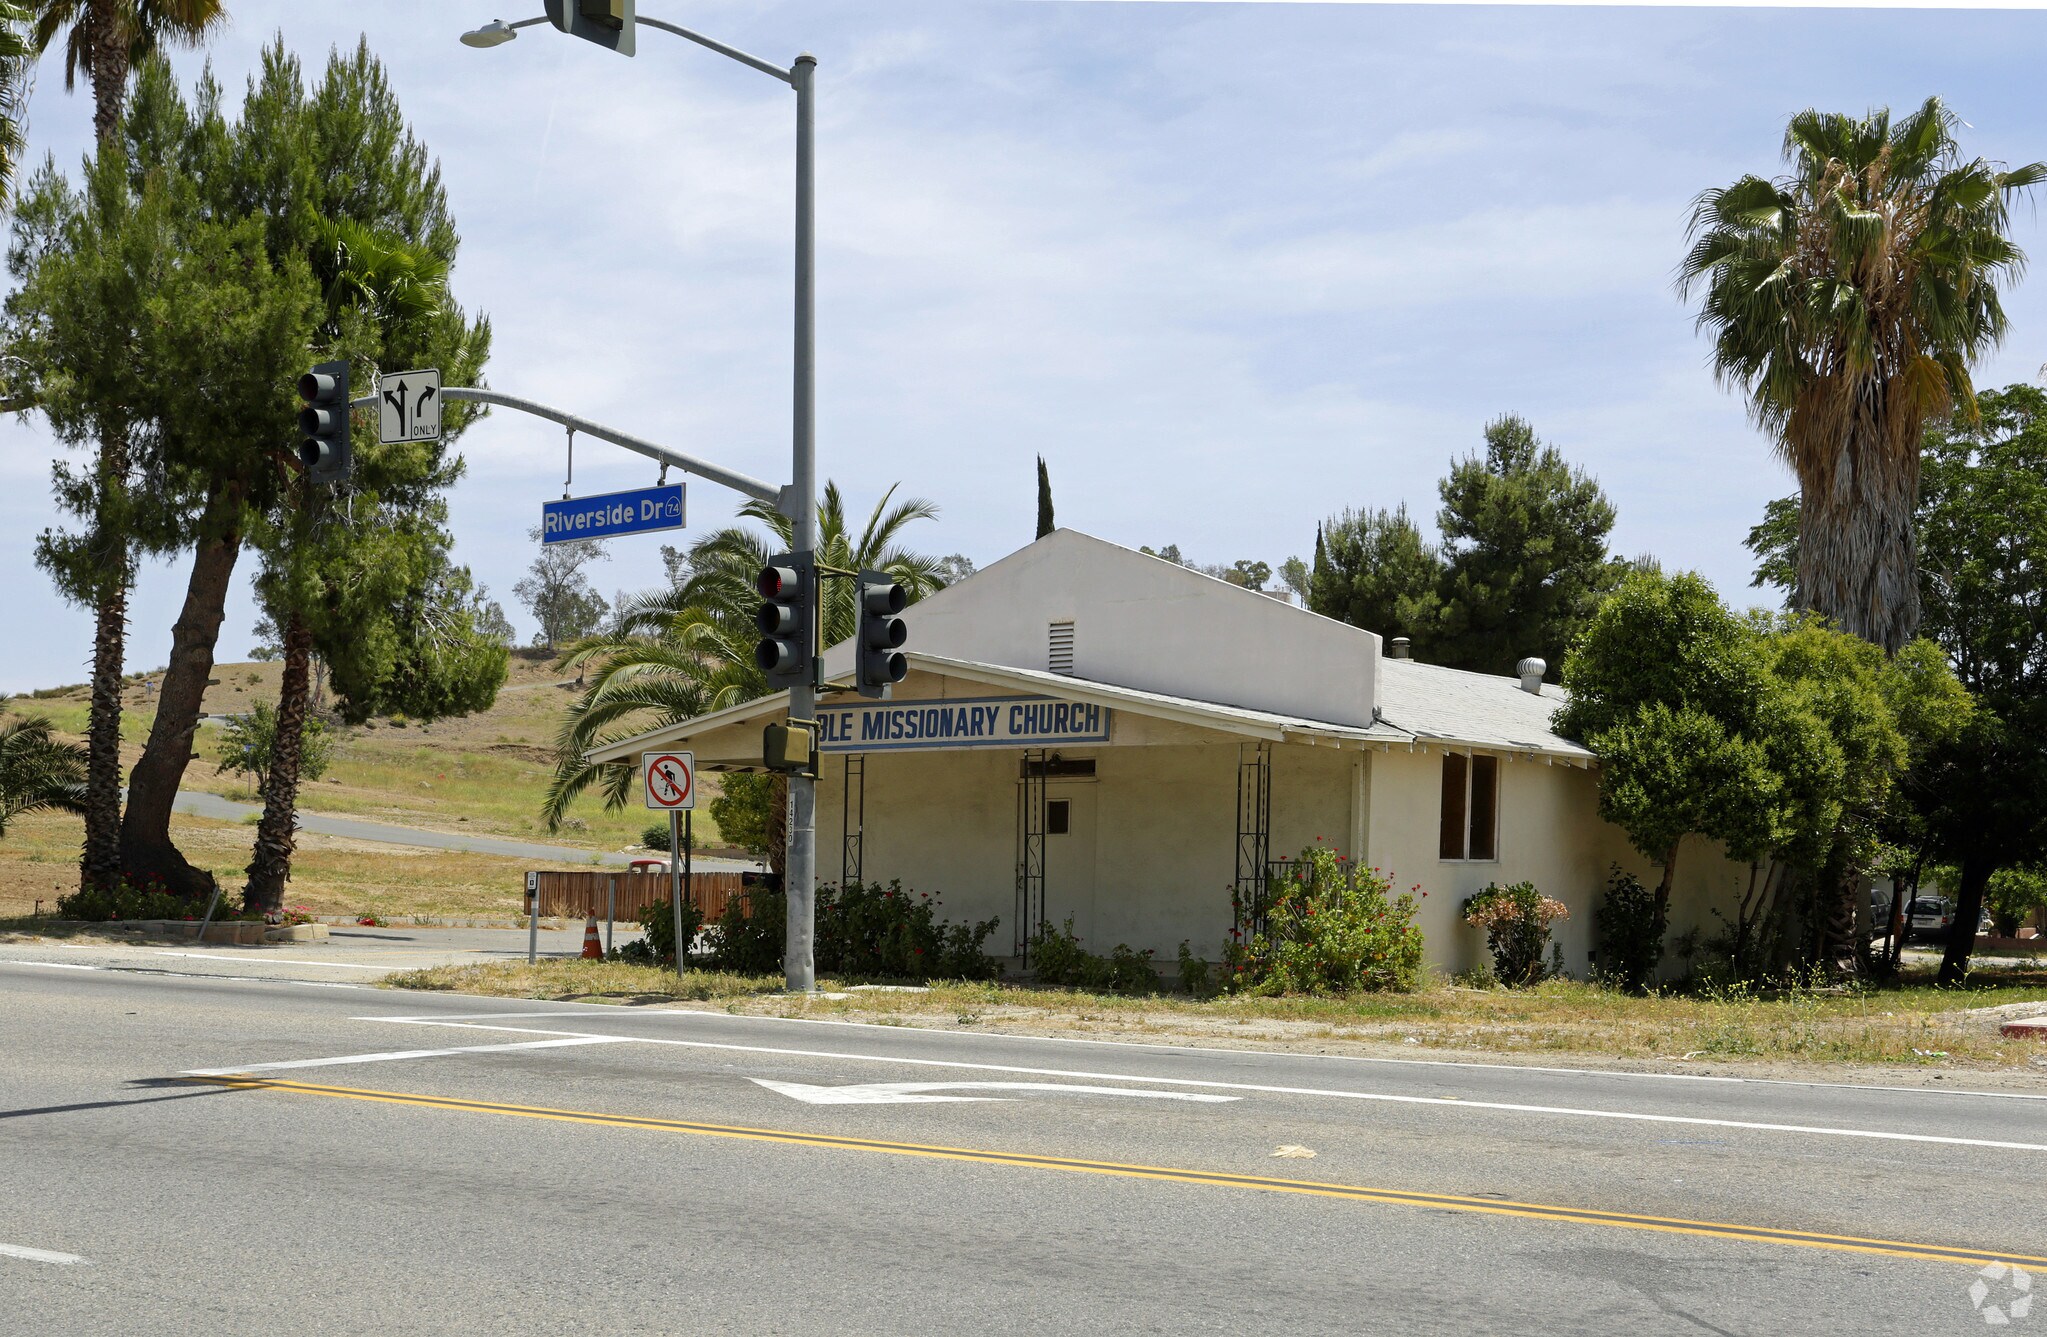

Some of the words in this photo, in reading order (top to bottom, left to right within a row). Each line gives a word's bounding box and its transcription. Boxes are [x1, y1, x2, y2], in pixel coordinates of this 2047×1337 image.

[413, 424, 437, 436] ONLY
[545, 505, 635, 534] Riverside
[641, 499, 664, 521] Dr
[667, 503, 680, 515] 74
[861, 706, 1000, 741] MISSIONARY
[1009, 703, 1100, 735] CHURCH
